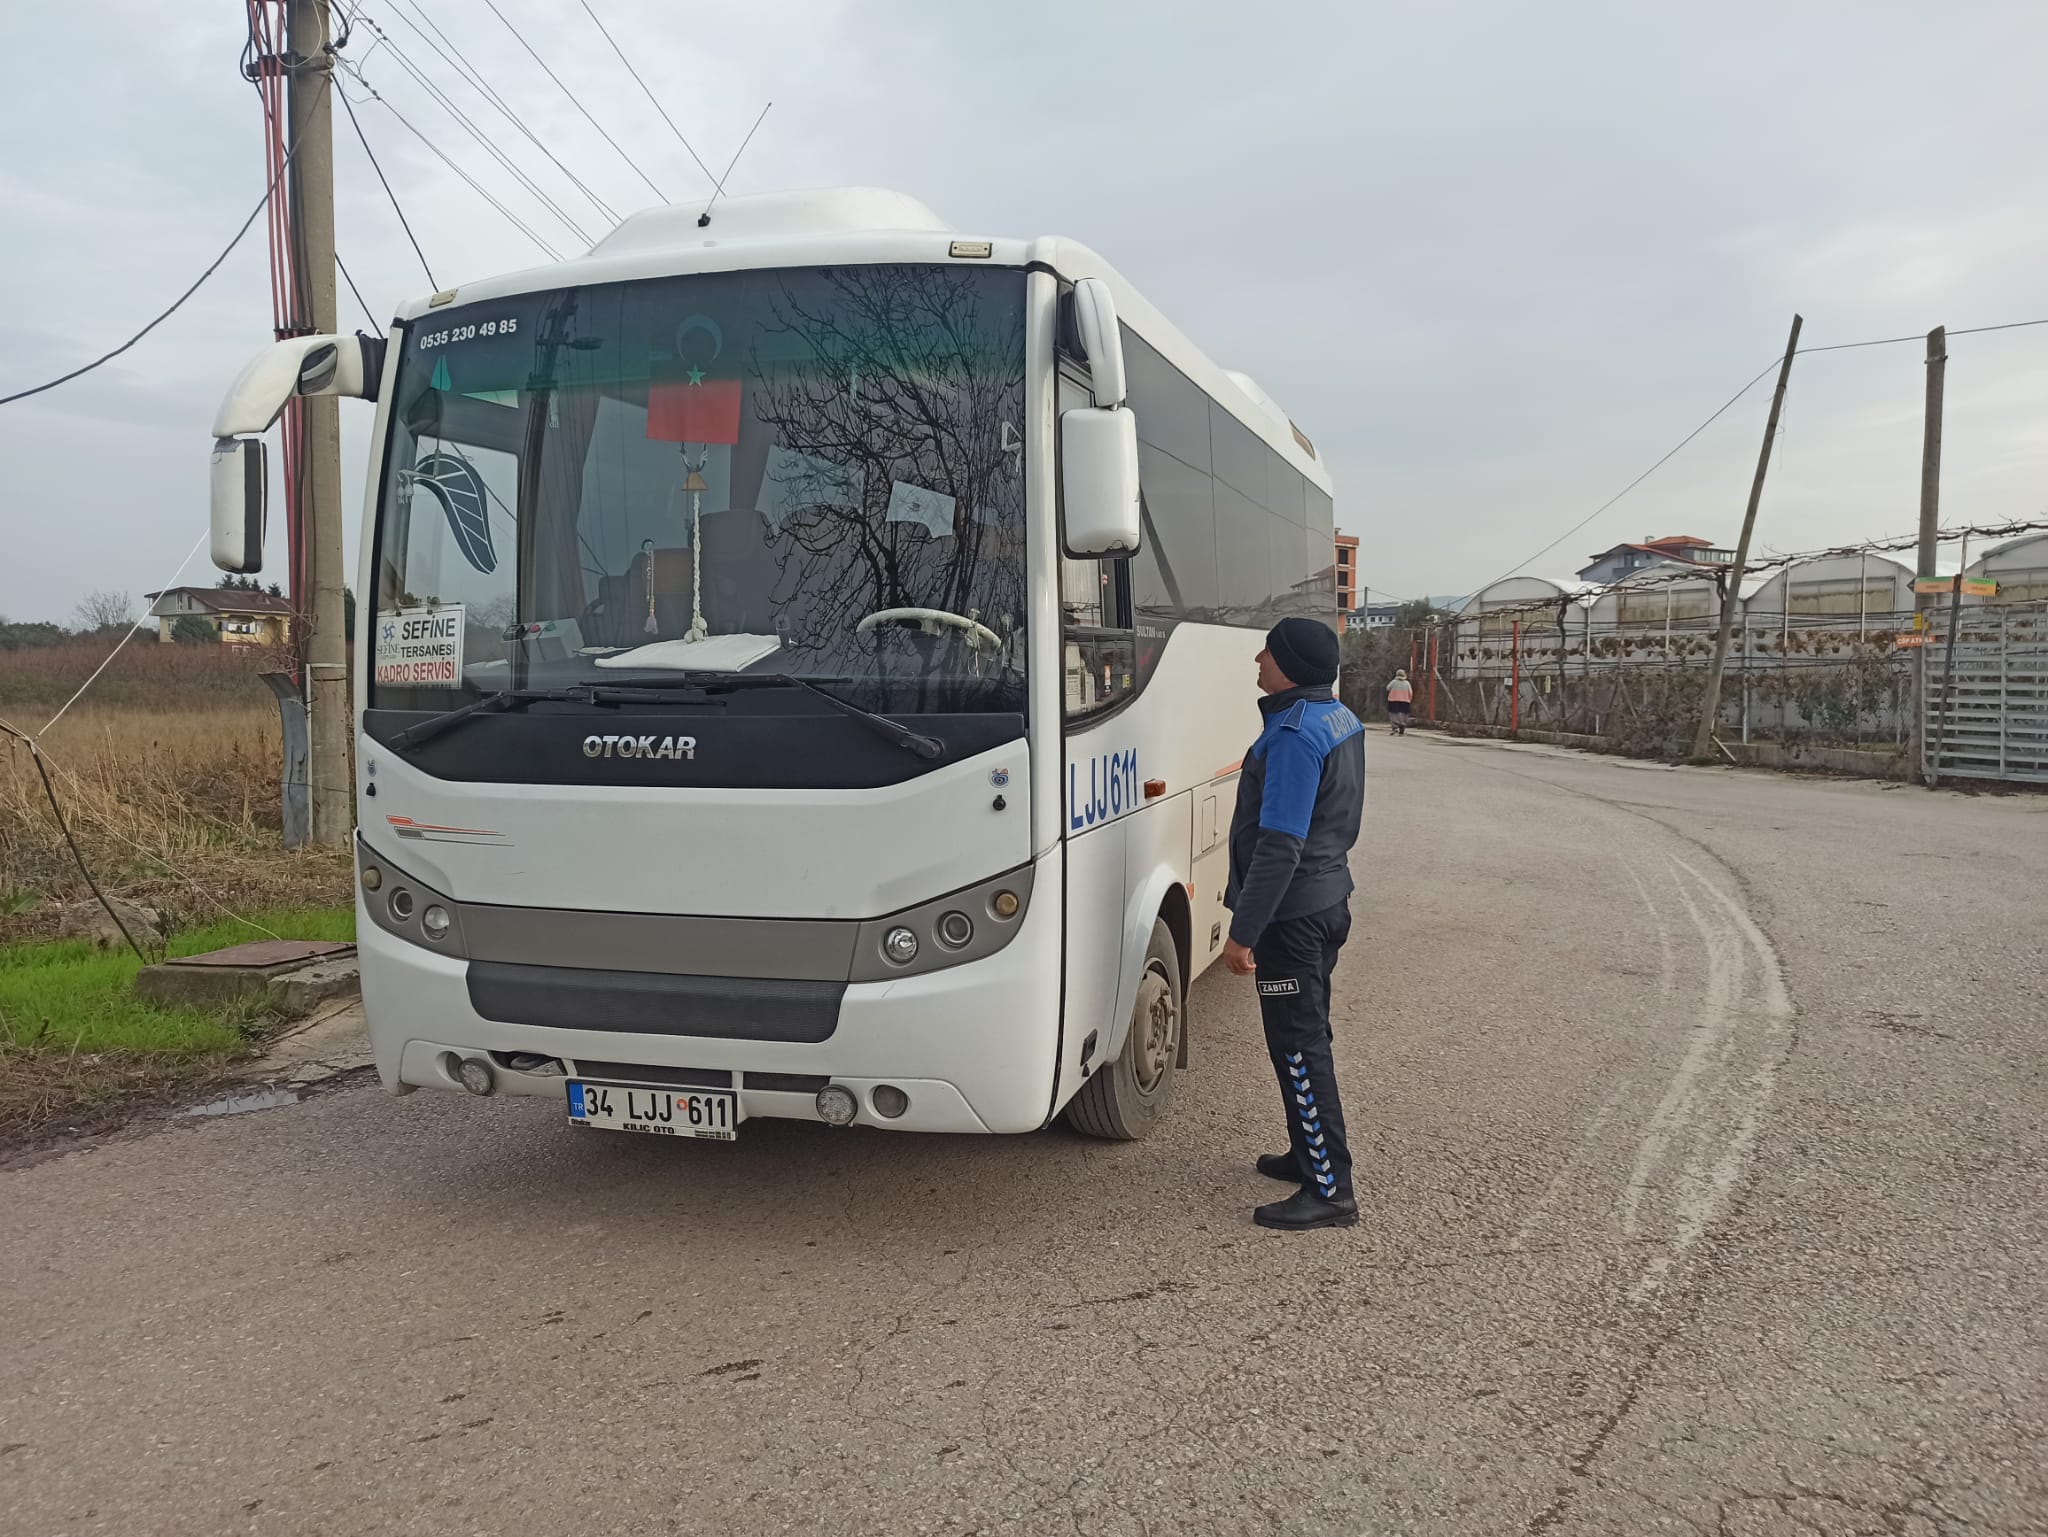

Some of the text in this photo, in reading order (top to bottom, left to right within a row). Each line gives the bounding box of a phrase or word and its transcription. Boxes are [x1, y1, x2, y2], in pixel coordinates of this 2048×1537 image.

[420, 318, 517, 350] 0535 230 49 85
[401, 615, 456, 640] SEFİNE
[401, 641, 456, 658] TERSANESİ
[377, 657, 455, 684] KADRO SERVİSİ
[582, 735, 697, 760] OTOKAR
[1070, 748, 1138, 831] LJJ611
[1261, 982, 1295, 993] ZABITA
[573, 1102, 584, 1111] TR
[585, 1087, 726, 1127] 34 LJJ 611
[653, 1125, 675, 1135] OTO
